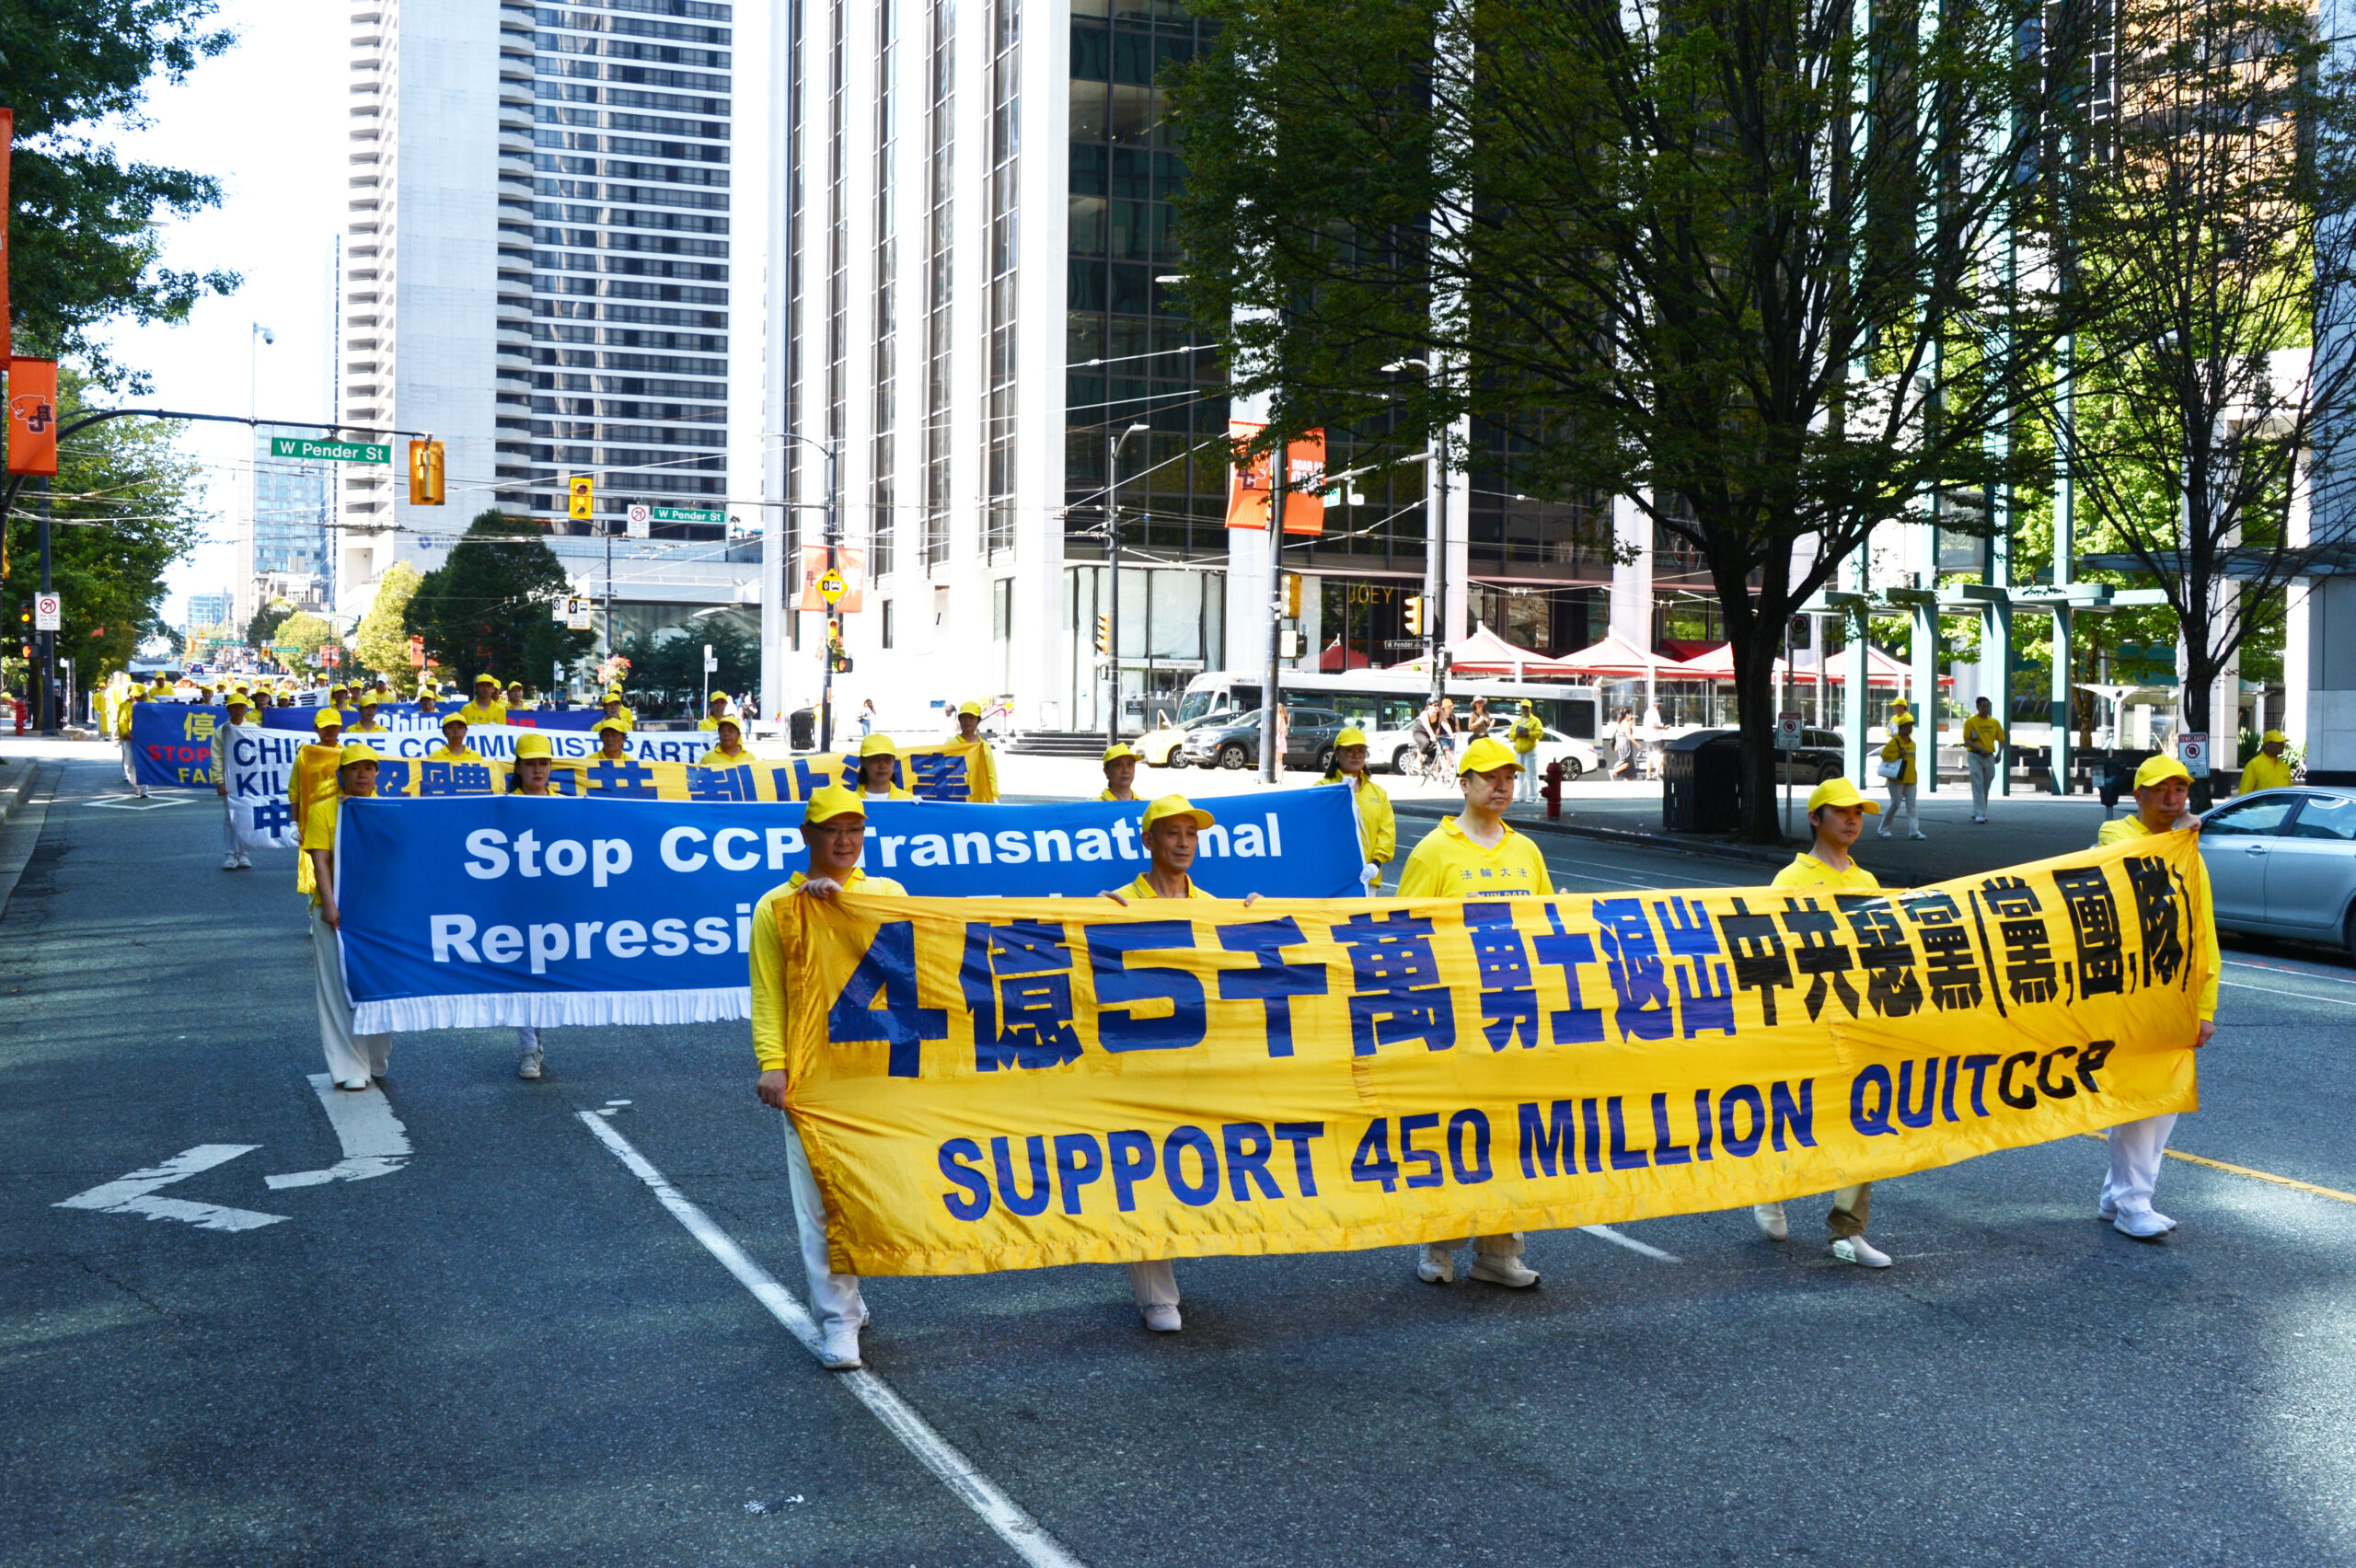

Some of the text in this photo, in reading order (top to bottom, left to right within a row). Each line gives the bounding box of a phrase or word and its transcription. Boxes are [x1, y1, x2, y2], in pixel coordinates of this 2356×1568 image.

[280, 441, 383, 460] W Pender St
[1291, 459, 1312, 472] ROAR
[659, 510, 721, 522] W Pender St
[1349, 584, 1394, 604] JOEY
[147, 744, 211, 763] STOP
[465, 828, 632, 887] Stop
[660, 826, 805, 872] CCP
[938, 1121, 1324, 1222] SUPPORT
[1350, 1108, 1494, 1193] 450
[1518, 1078, 1819, 1179] MILLION
